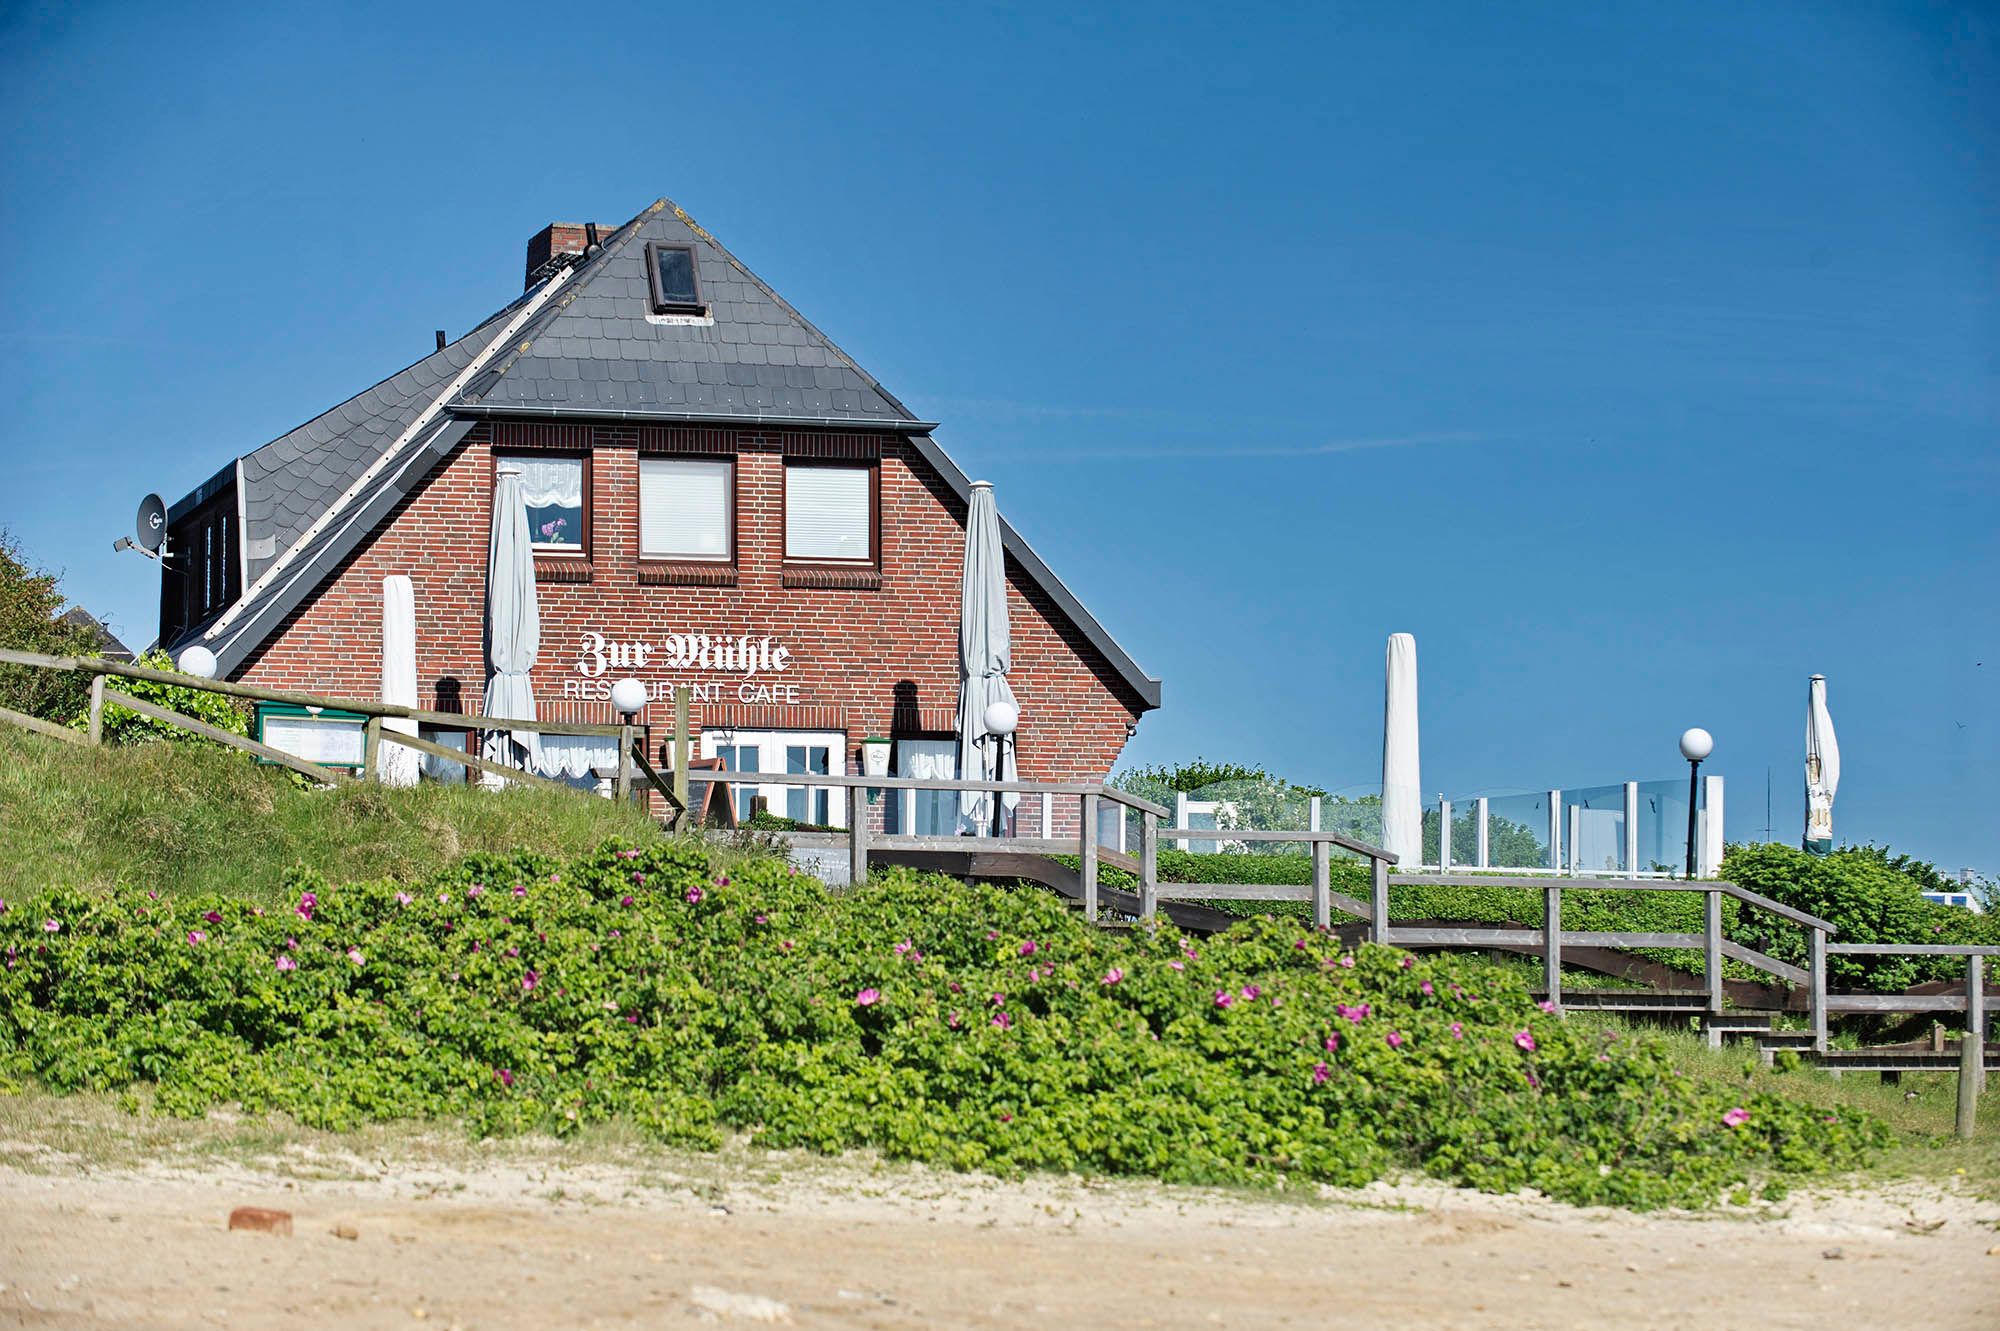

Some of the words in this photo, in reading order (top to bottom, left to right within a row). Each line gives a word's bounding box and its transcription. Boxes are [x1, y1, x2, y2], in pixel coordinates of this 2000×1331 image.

[577, 632, 651, 678] Zur
[664, 634, 790, 681] Mühle
[564, 680, 725, 703] RESURNT
[738, 683, 800, 704] CAFE
